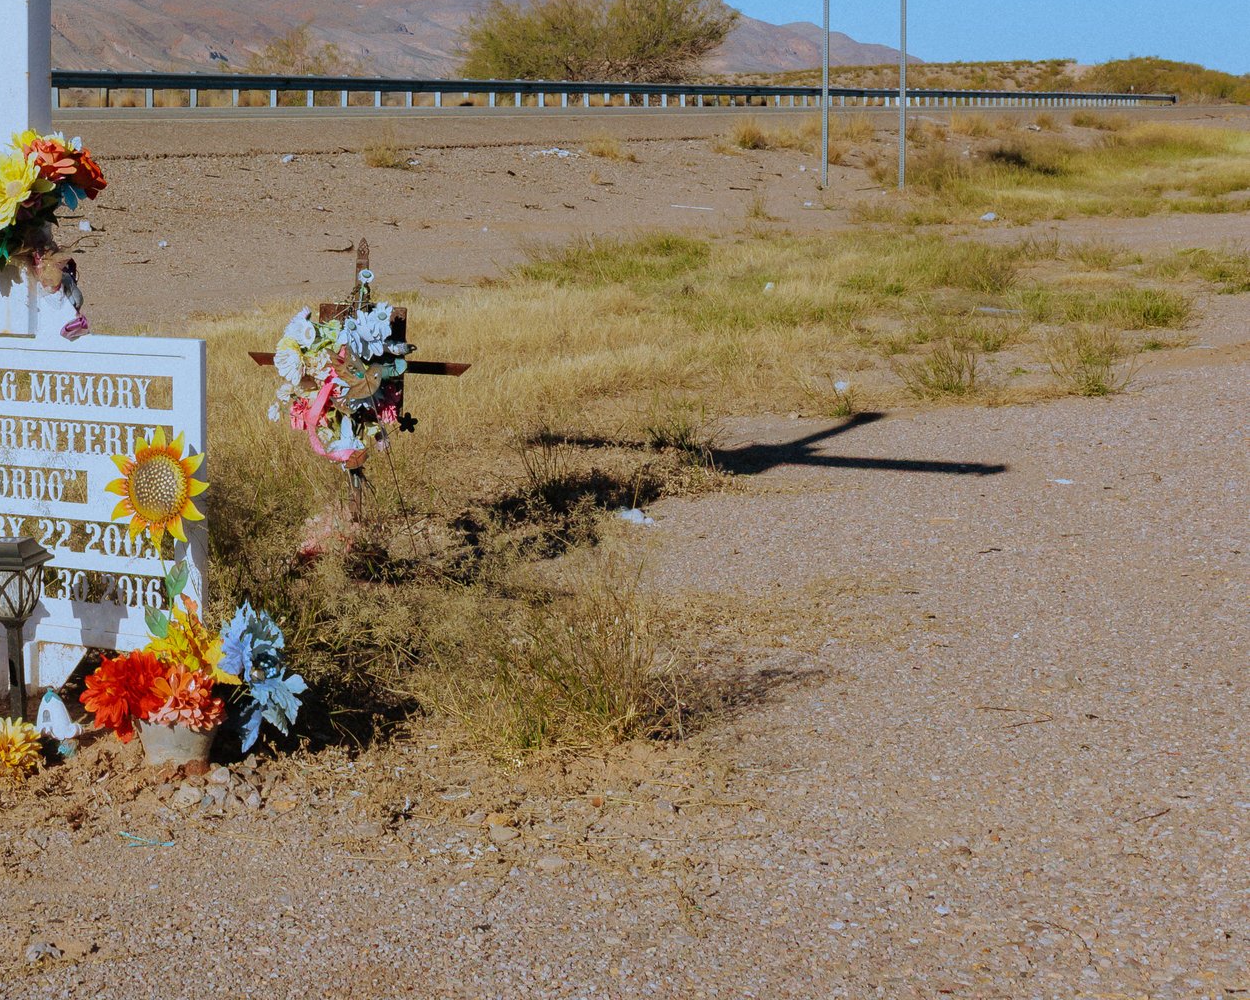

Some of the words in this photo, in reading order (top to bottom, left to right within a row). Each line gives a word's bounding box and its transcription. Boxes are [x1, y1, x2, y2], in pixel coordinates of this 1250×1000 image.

[29, 372, 152, 410] MEMORY
[38, 518, 72, 552] 22
[57, 569, 90, 602] 30
[100, 573, 163, 611] 2016
